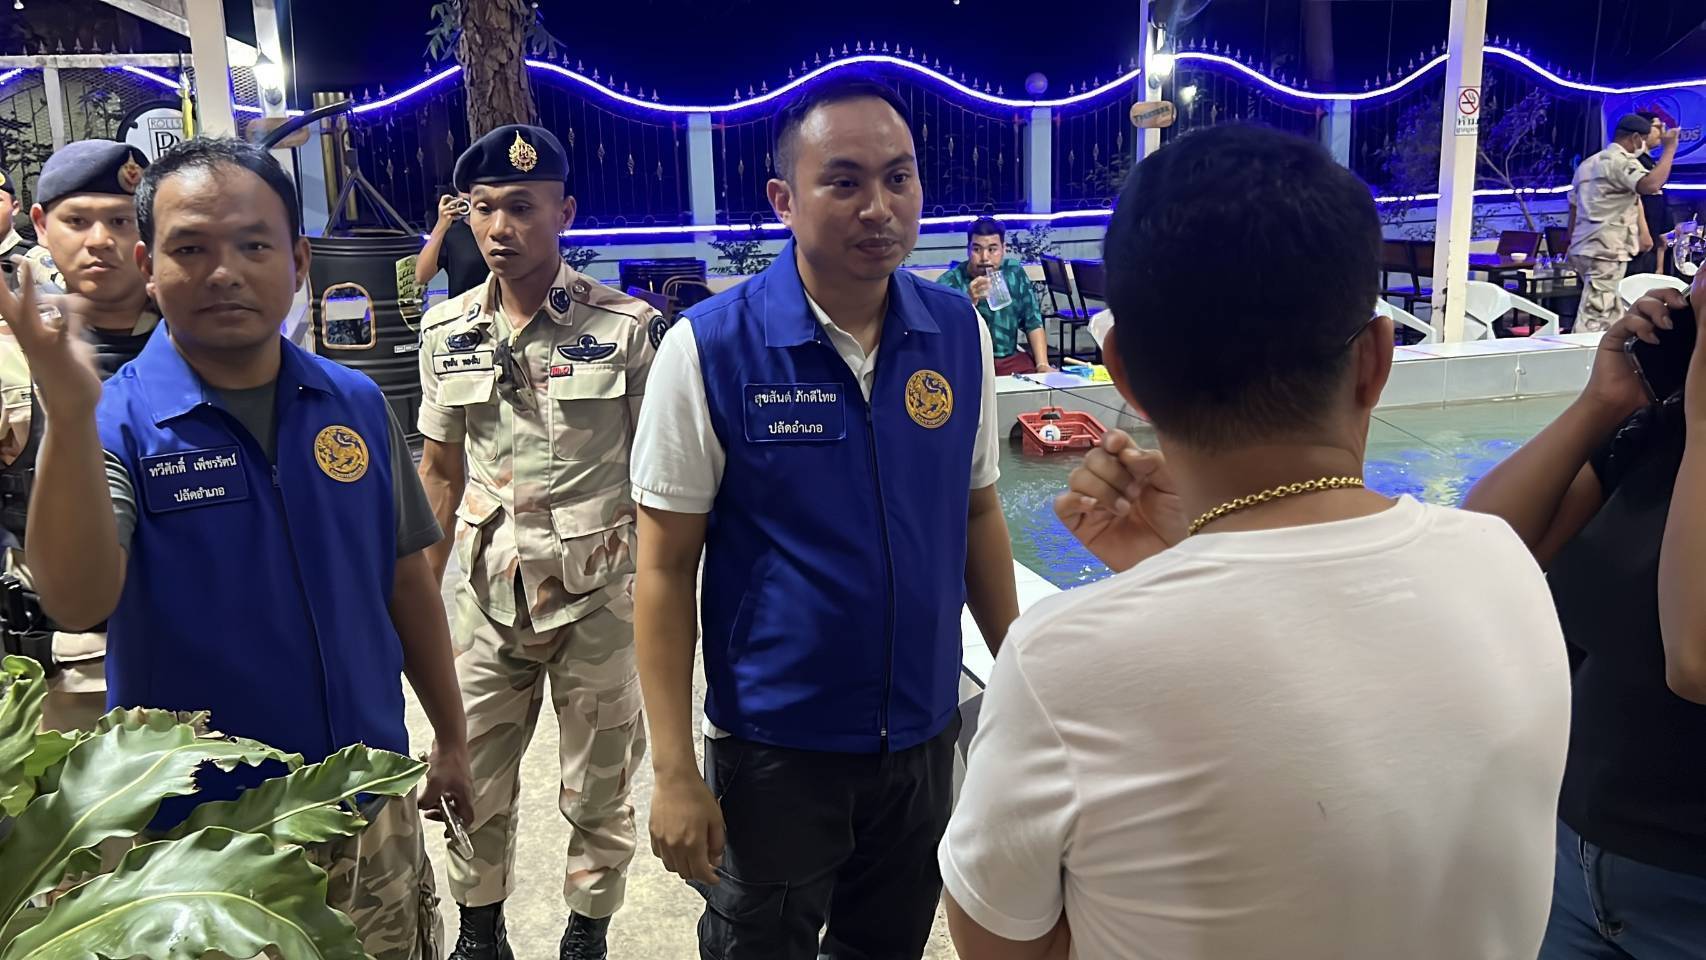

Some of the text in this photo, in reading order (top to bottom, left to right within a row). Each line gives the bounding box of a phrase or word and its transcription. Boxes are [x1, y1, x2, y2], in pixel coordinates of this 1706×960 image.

[795, 389, 837, 403] ภักดีไทย
[768, 420, 823, 434] ปลัดอำเภอ
[1045, 430, 1055, 441] 5
[148, 456, 186, 477] ทวีศักดิ์
[174, 486, 225, 502] ปลัดอำเภอ
